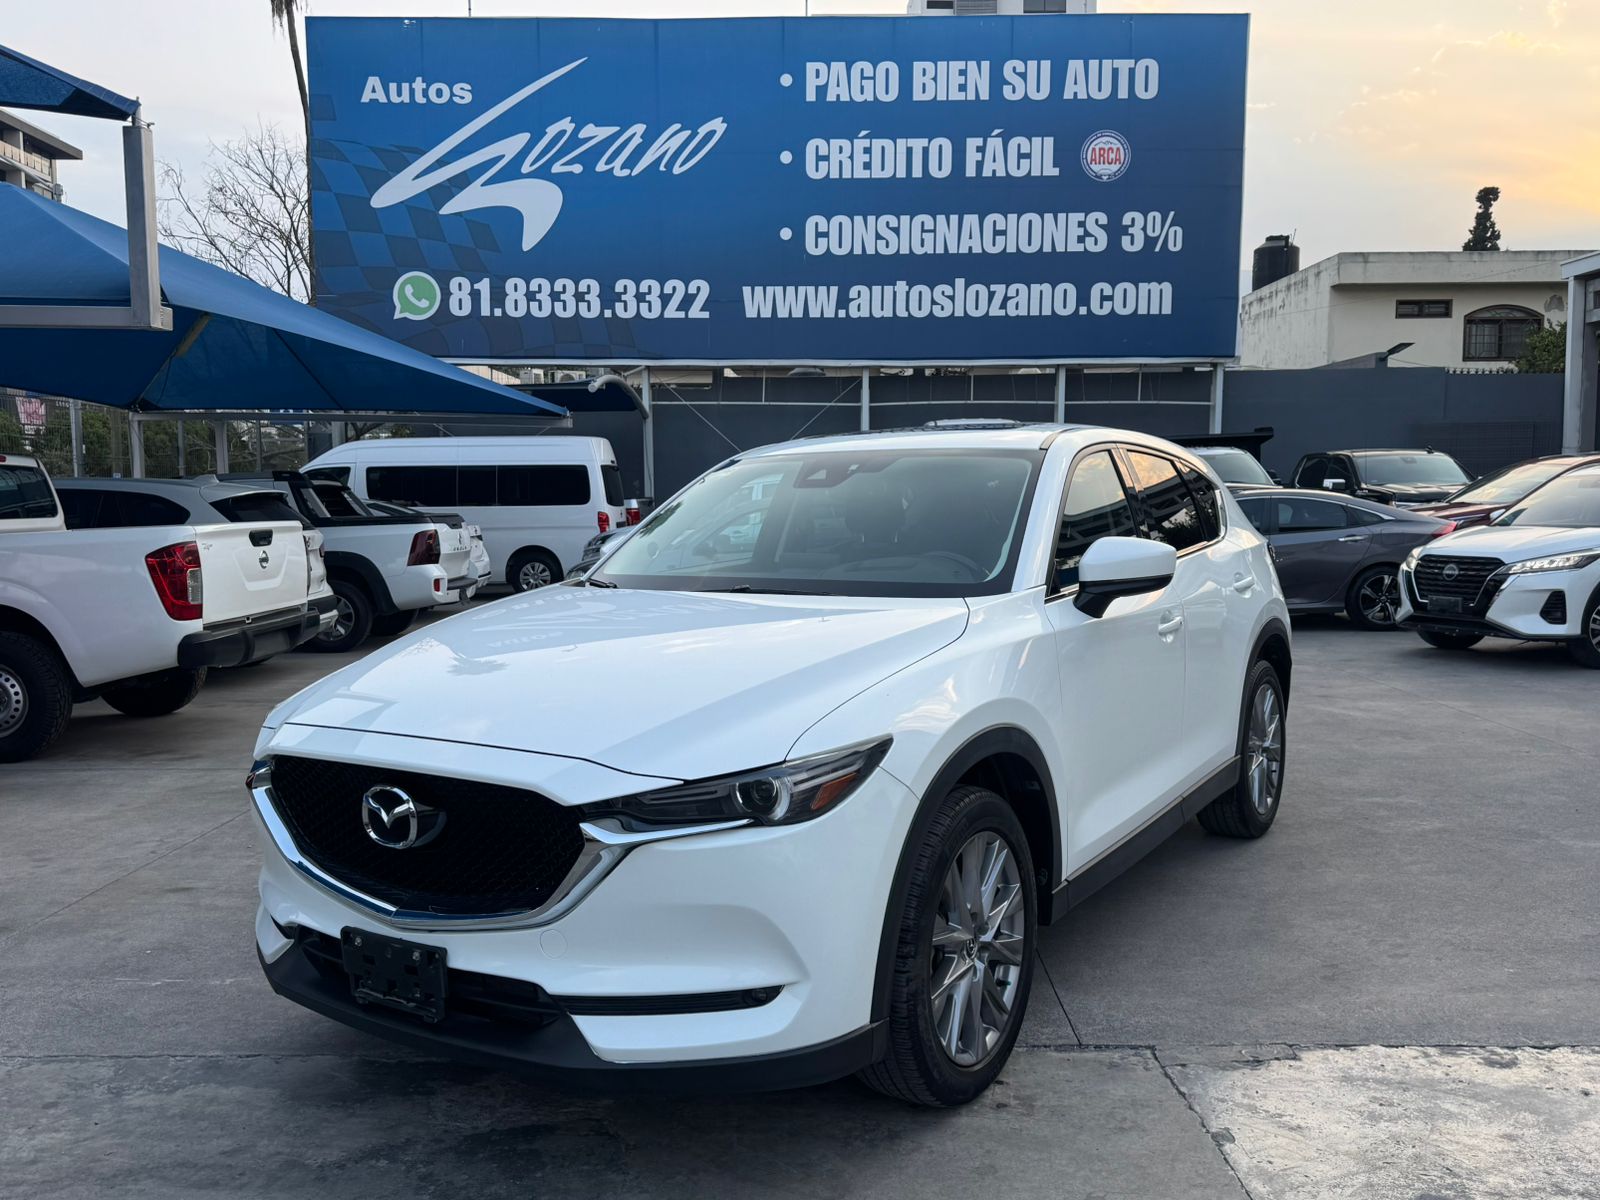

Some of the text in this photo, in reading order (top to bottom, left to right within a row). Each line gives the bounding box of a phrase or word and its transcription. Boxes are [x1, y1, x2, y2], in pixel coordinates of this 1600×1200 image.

[360, 76, 472, 104] Autos
[806, 58, 1160, 102] PAGO BIEN SU AUTO
[370, 57, 727, 251] Lozano
[805, 130, 952, 180] CRÉDITO
[965, 129, 1060, 178] FÁCIL
[1090, 146, 1121, 165] ARCA
[805, 211, 1183, 256] CONSIGNACIONES 3%
[448, 276, 710, 319] 81.8333.3322
[742, 277, 1173, 319] www.autoslozano.com
